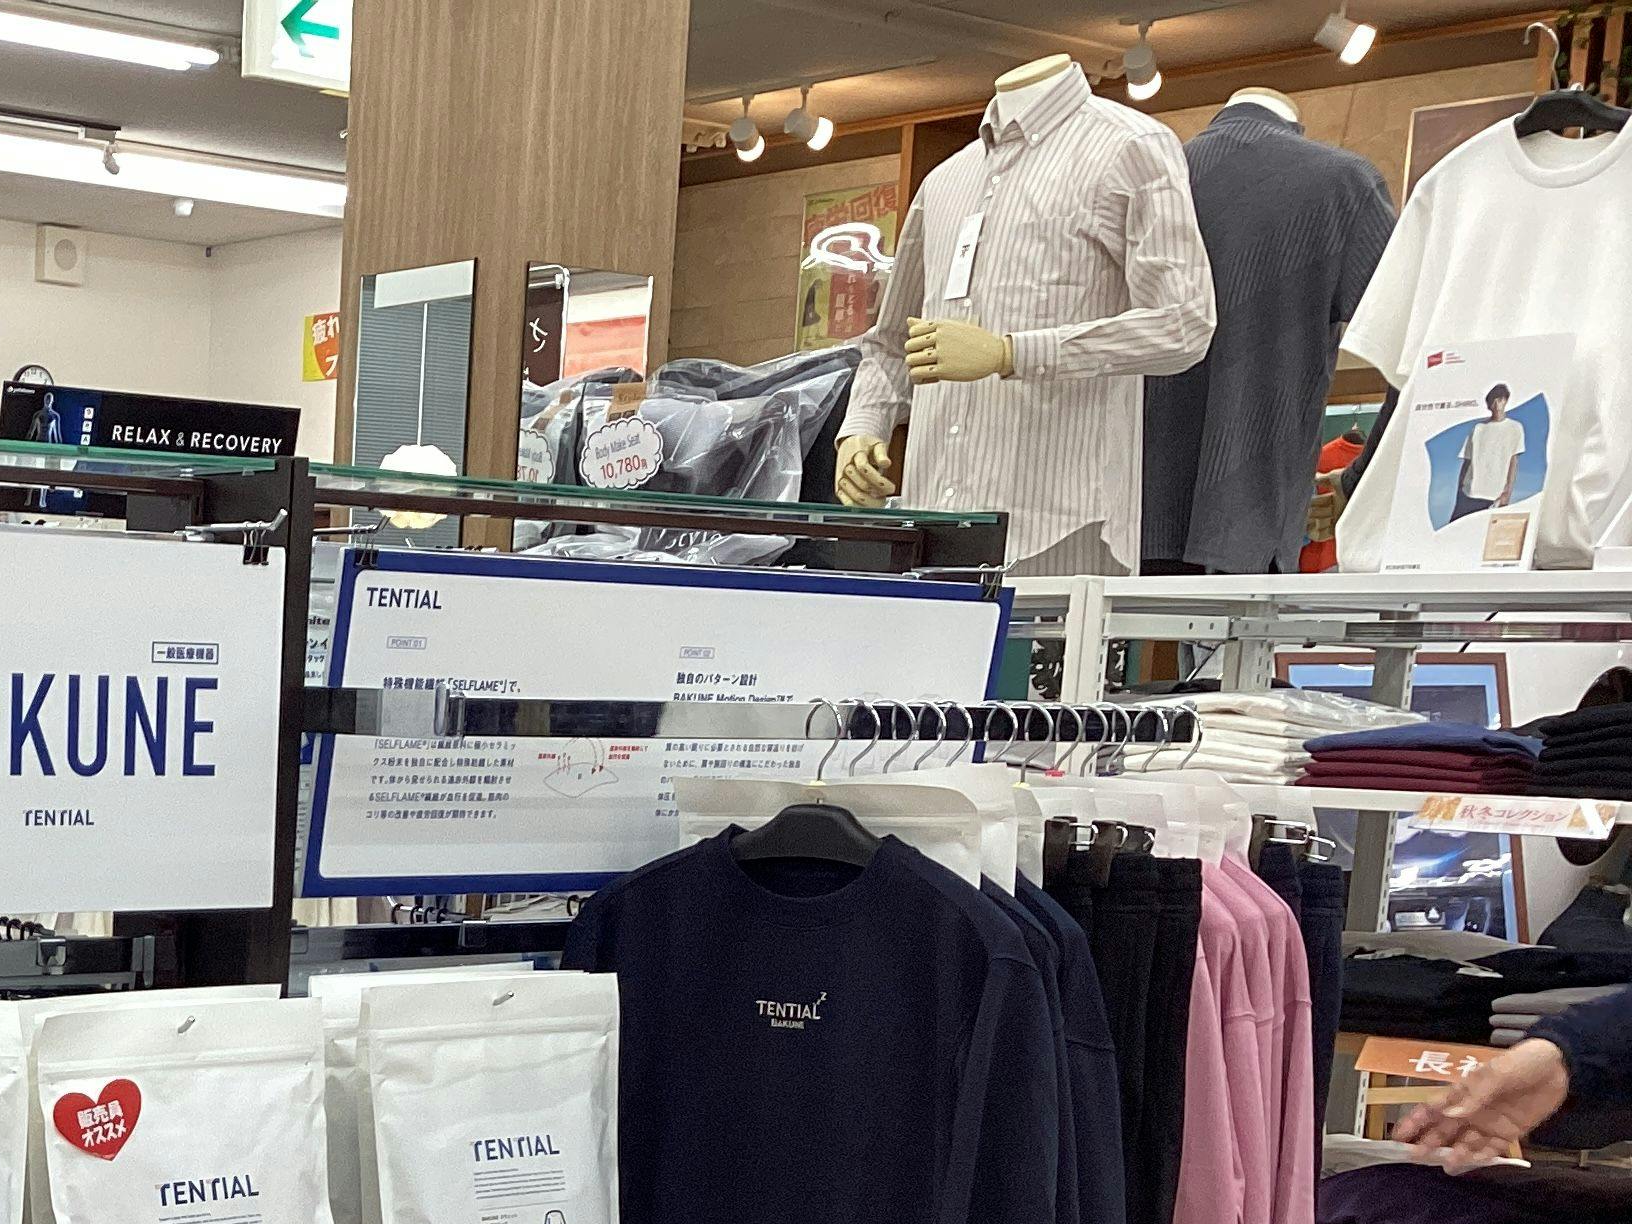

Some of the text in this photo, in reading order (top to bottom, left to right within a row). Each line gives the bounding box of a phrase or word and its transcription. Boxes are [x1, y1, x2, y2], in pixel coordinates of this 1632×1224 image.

[111, 425, 282, 454] RELAX & RECOVERY
[367, 587, 442, 609] TENTIAL
[157, 646, 214, 660] 一般医療機器
[391, 639, 411, 647] POINT
[23, 808, 94, 826] TENTIAL
[1460, 805, 1569, 822] 秋冬コレクション
[756, 1000, 821, 1020] TENTIAL
[77, 1100, 124, 1129] 販売員
[81, 1119, 127, 1147] オススメ
[470, 1135, 560, 1161] TENTIAL
[155, 1174, 259, 1206] TENTIAL
